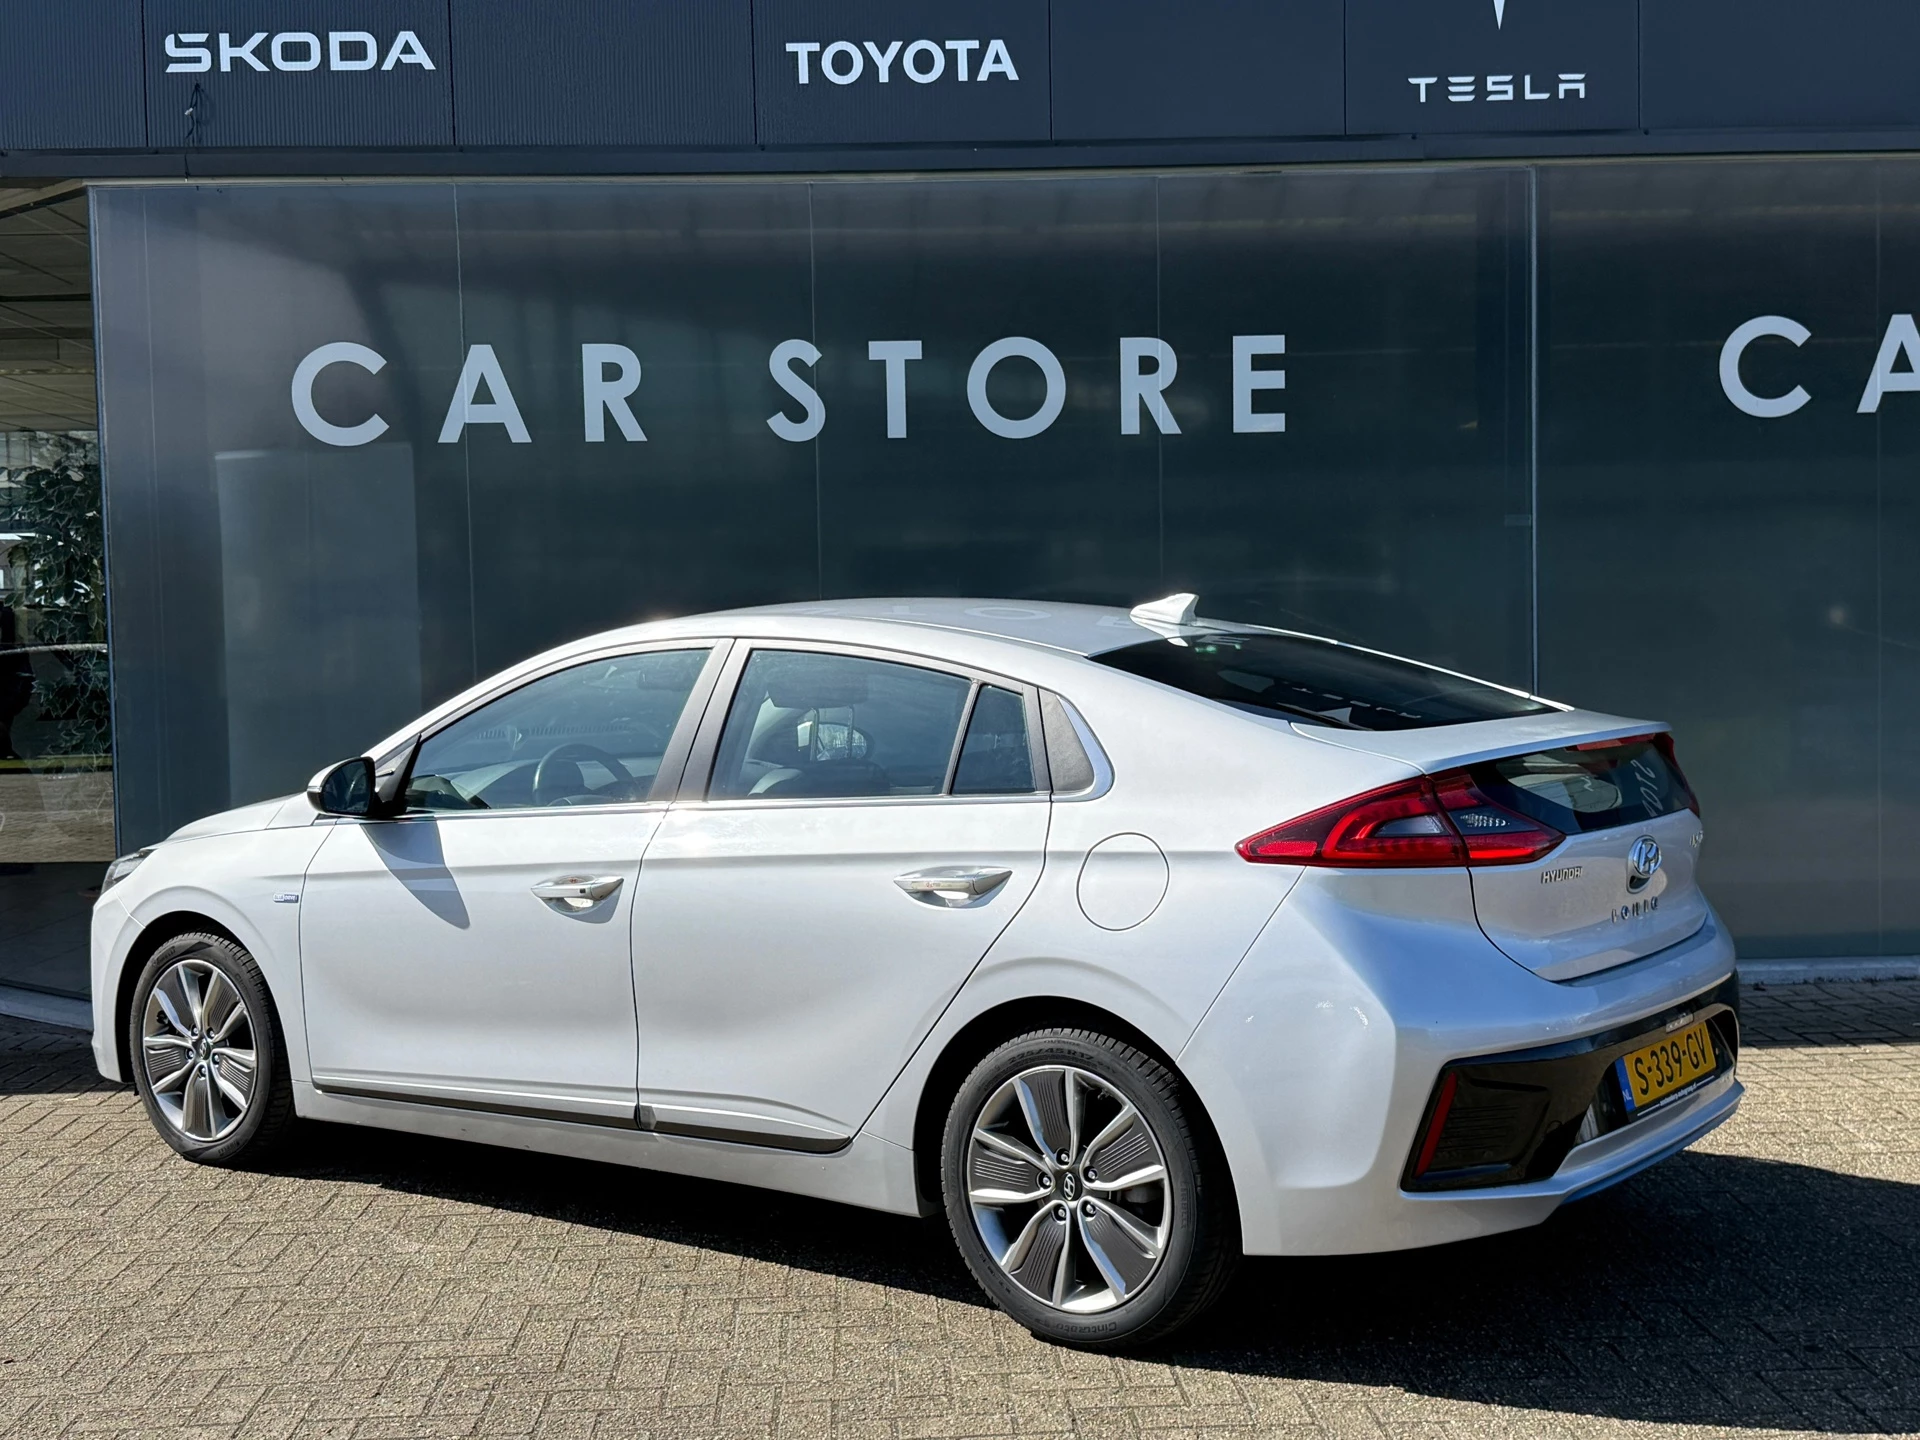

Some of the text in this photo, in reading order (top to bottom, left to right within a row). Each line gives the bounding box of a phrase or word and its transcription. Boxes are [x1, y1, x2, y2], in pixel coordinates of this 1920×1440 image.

[785, 39, 1019, 85] TOYOTA
[1408, 73, 1587, 103] TESLA
[291, 335, 1286, 447] CAR STORE
[1541, 866, 1583, 884] HYUNDAI
[1634, 1027, 1707, 1096] S-339-GV
[1622, 1089, 1633, 1103] NL
